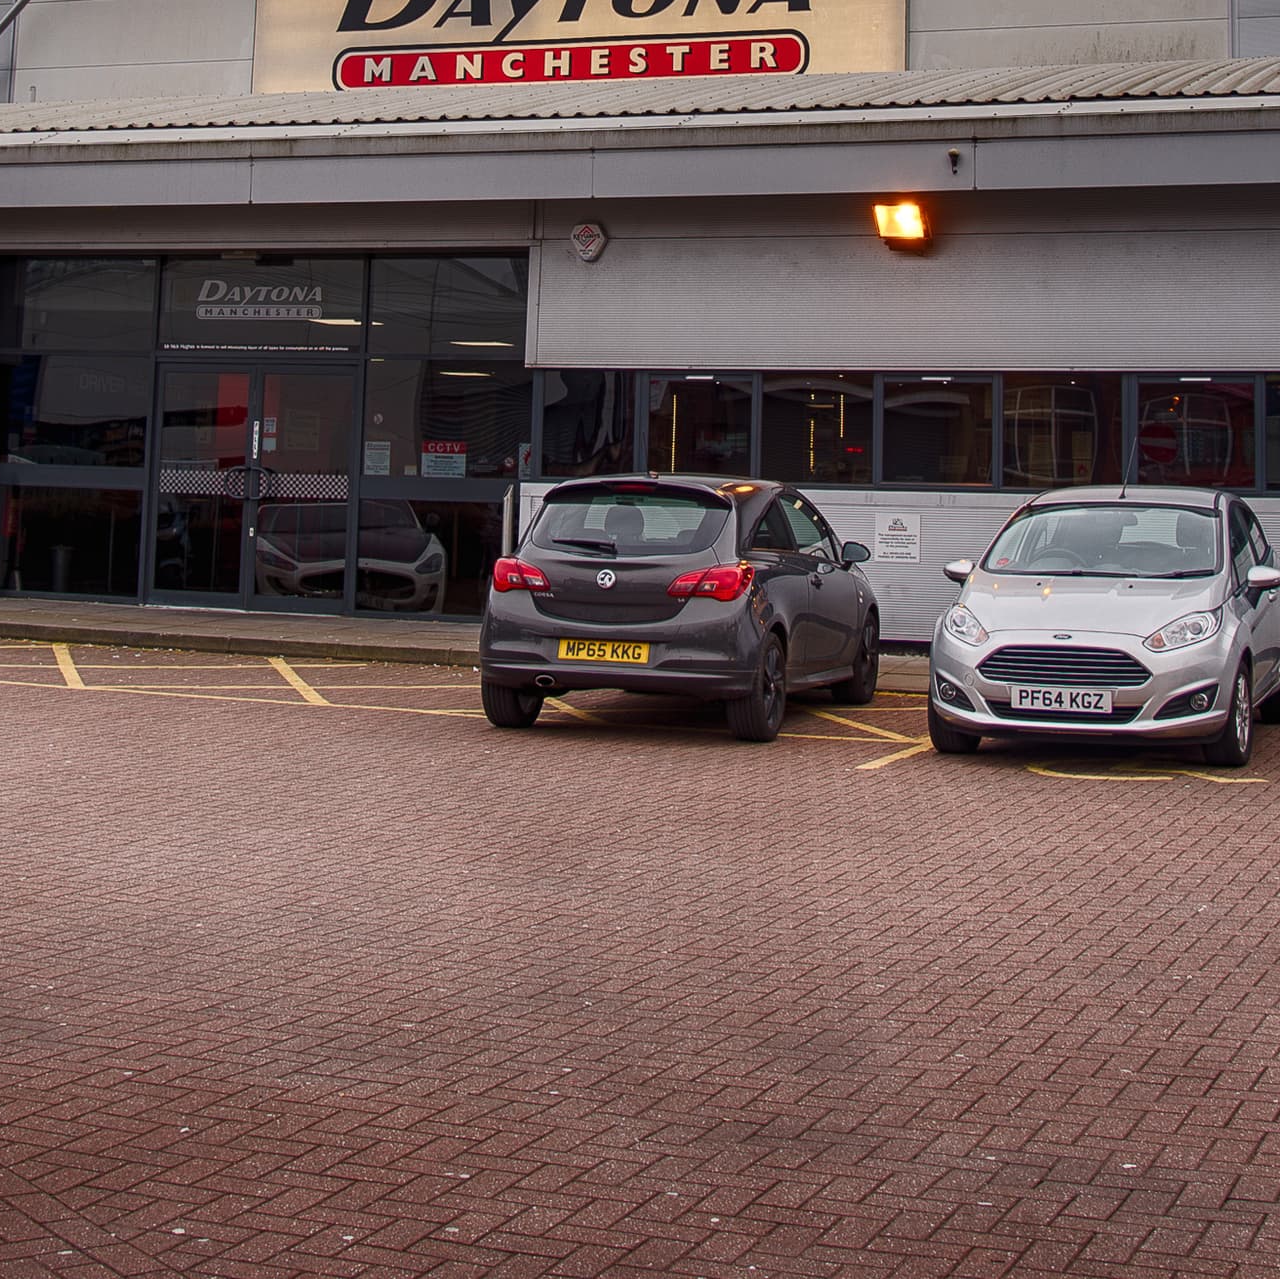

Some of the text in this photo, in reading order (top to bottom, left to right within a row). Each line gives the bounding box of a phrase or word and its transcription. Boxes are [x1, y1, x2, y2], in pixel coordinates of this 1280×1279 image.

[363, 41, 780, 83] MANCHESTER
[204, 307, 316, 317] MANCHESTER
[428, 442, 461, 452] CCTV
[565, 640, 642, 660] MP65 KKG
[1018, 689, 1105, 710] PF64 KGZ
